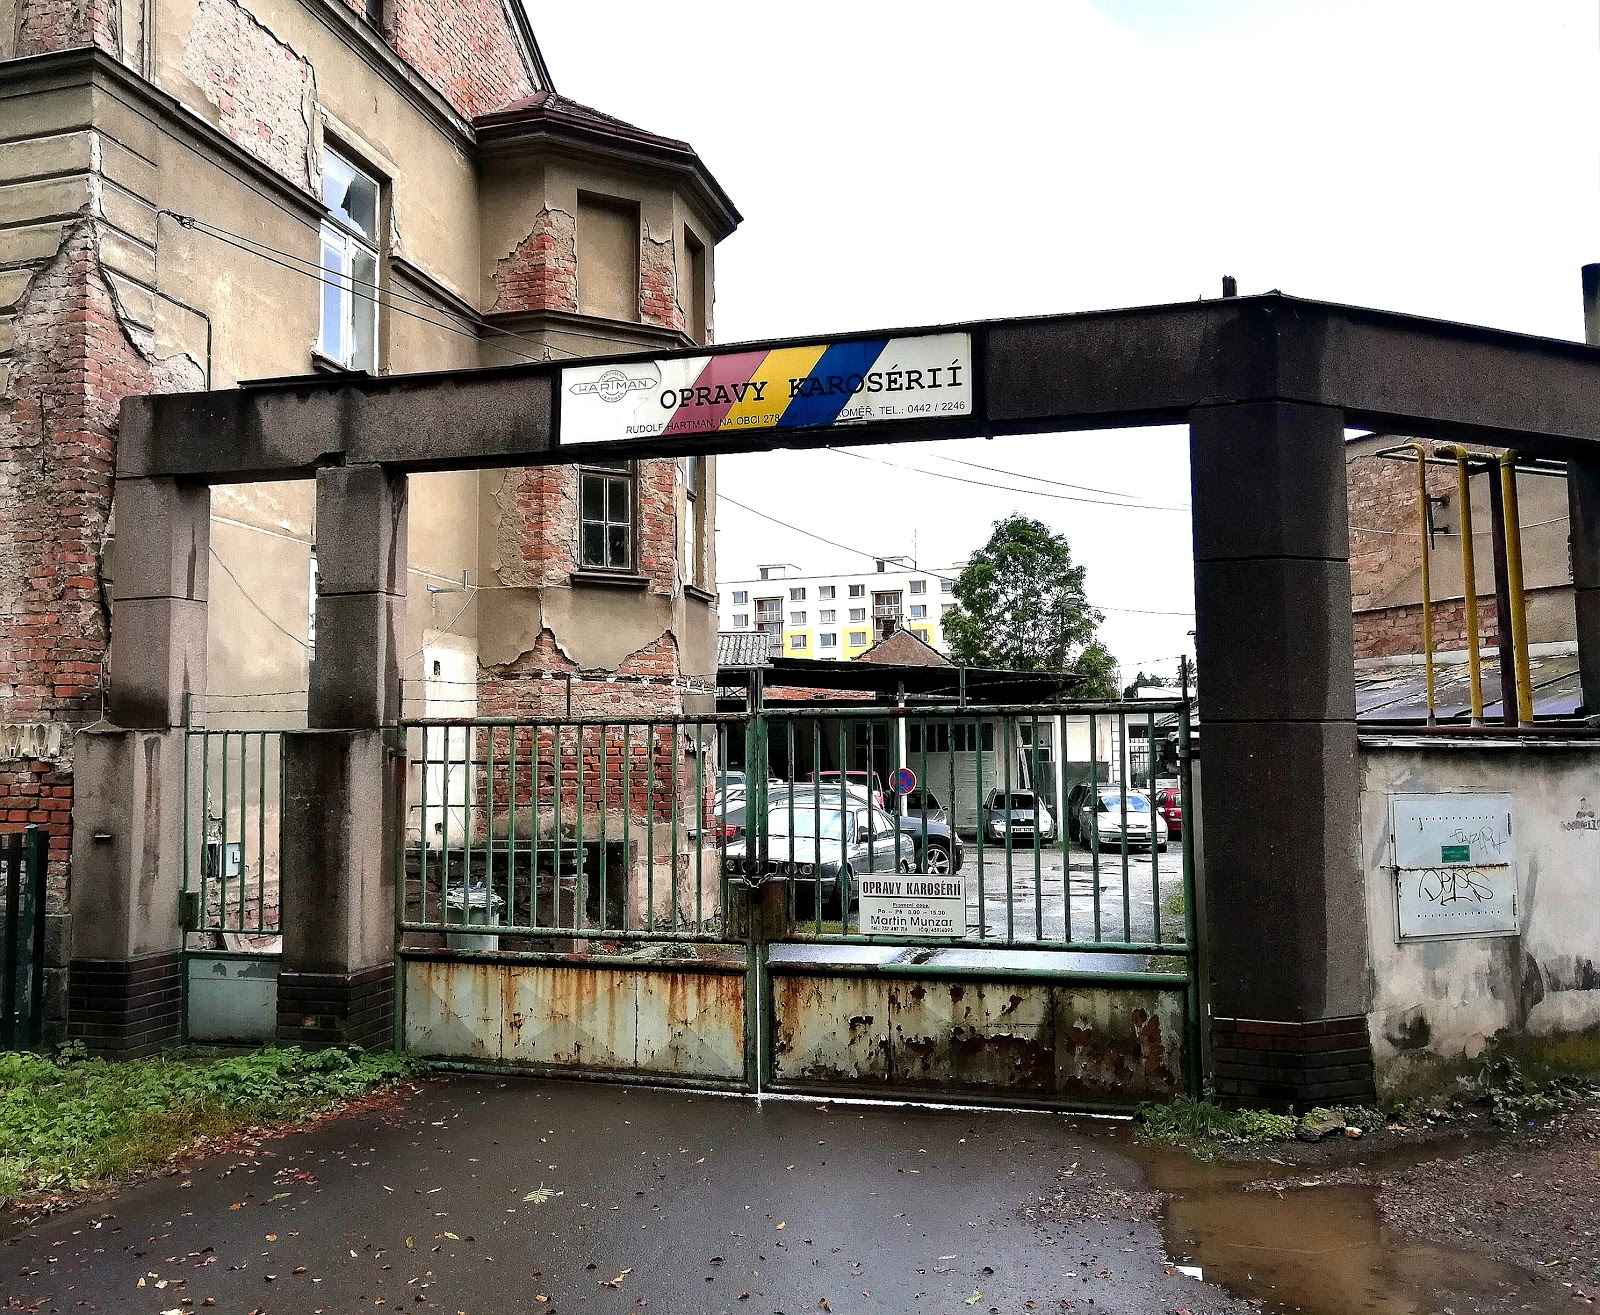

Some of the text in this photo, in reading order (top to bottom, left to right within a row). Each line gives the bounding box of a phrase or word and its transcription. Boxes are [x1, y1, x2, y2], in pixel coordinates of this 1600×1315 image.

[579, 380, 647, 392] HARTMAN
[660, 359, 963, 409] OPRAVY KAROSÉRIÍ
[626, 423, 663, 434] RUDOLF
[720, 417, 732, 426] NA
[736, 416, 760, 425] OBCI
[879, 405, 904, 416] TEL.:
[907, 403, 931, 414] 0442
[941, 401, 965, 412] 2246
[862, 880, 961, 896] OPRAVY KAROSÉRIÍ
[870, 915, 953, 927] Martin Munzar
